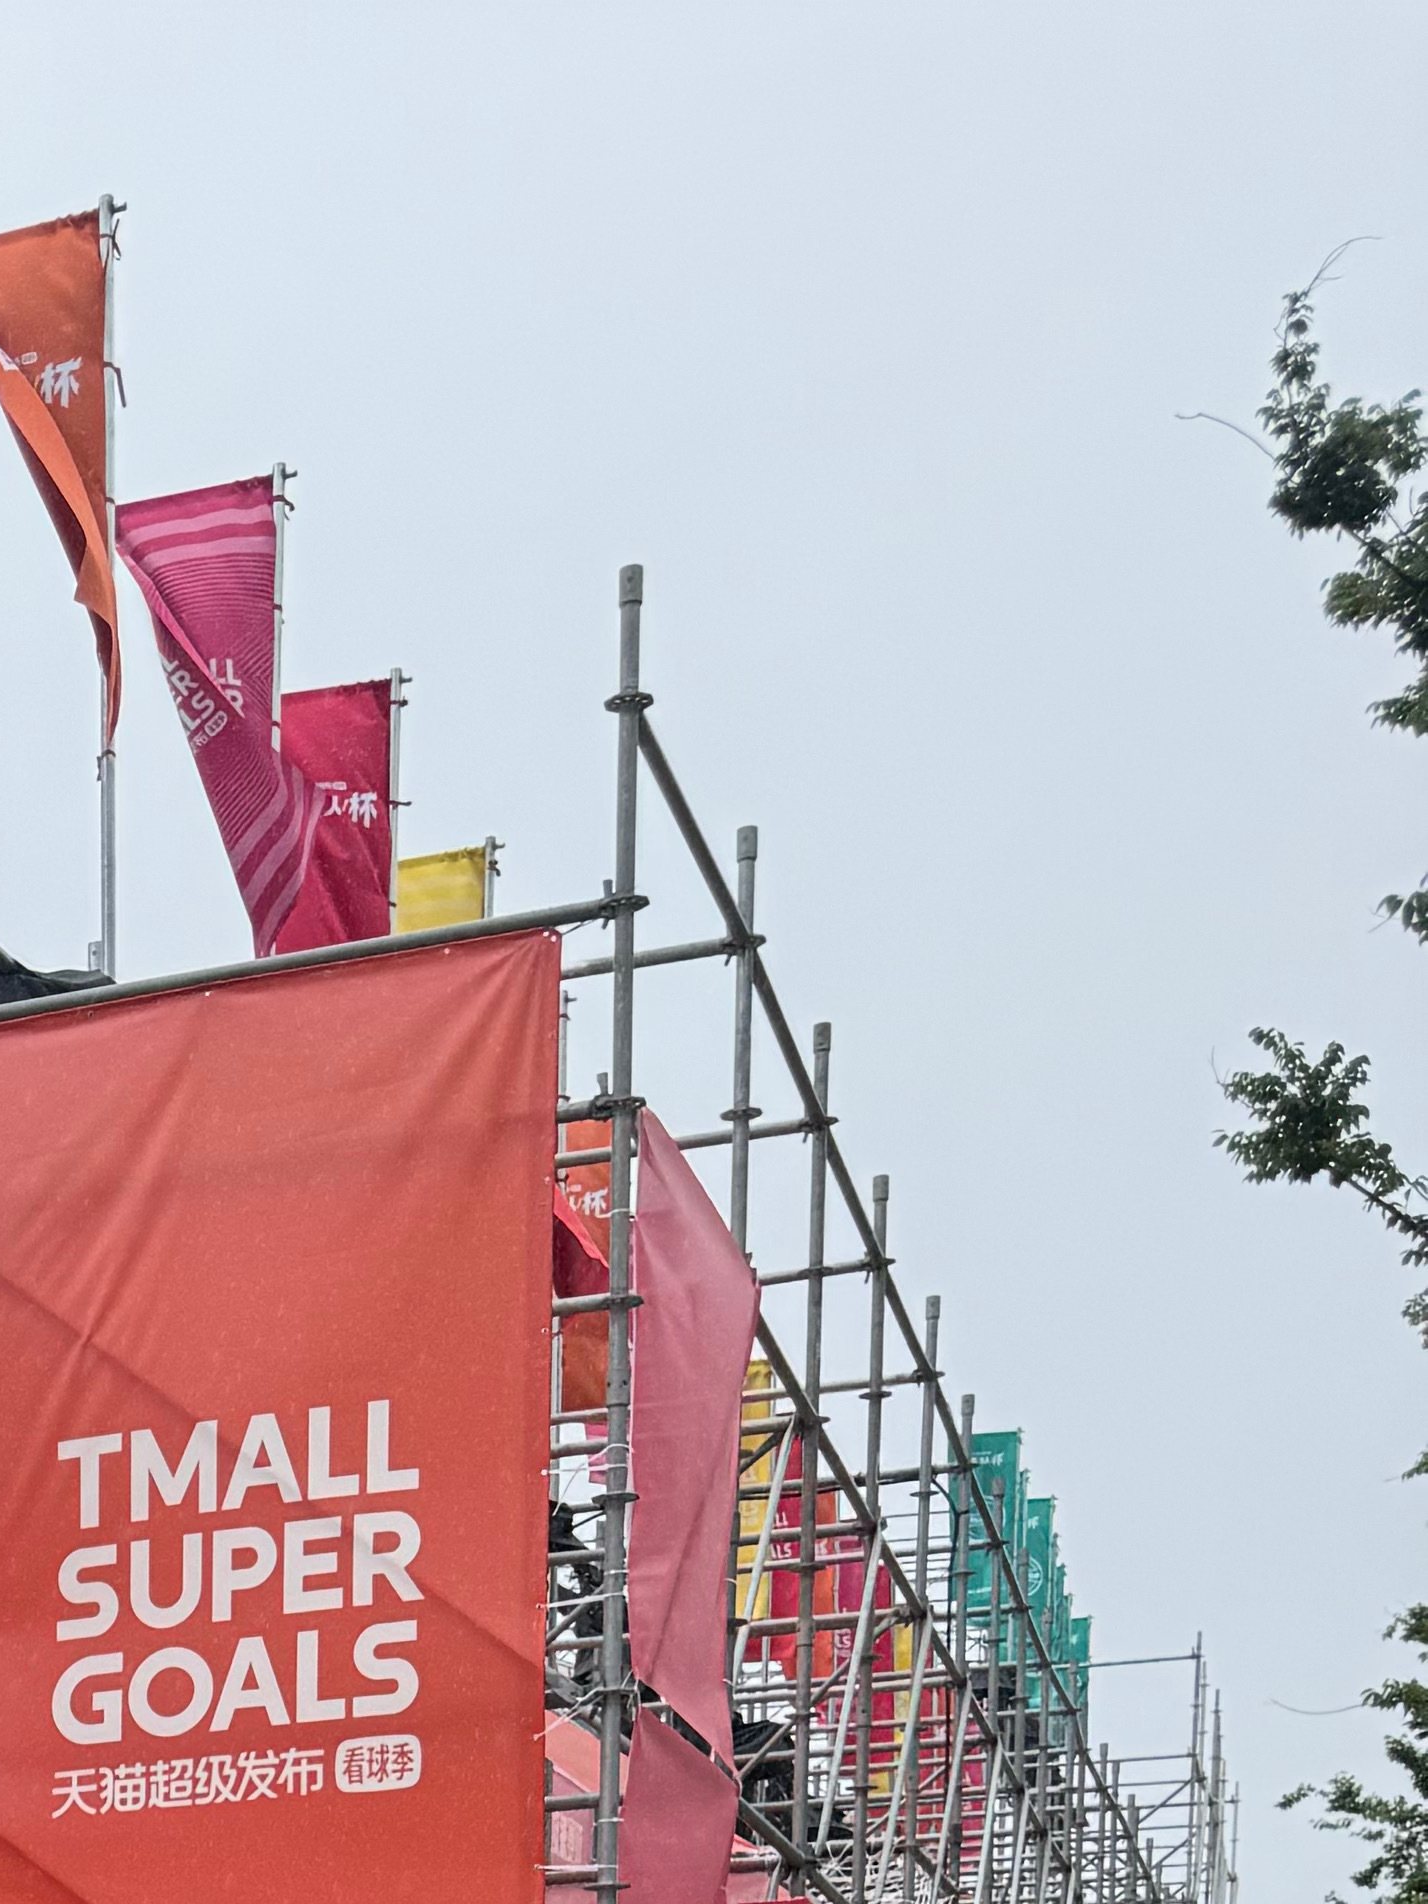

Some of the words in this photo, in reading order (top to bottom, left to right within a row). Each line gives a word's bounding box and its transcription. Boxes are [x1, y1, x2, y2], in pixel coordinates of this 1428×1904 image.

[57, 1399, 420, 1530] TMALL
[56, 1511, 426, 1642] SUPER
[51, 1619, 420, 1745] GOALS
[51, 1748, 325, 1819] 天猫超级发布
[341, 1741, 415, 1786] 看球季
